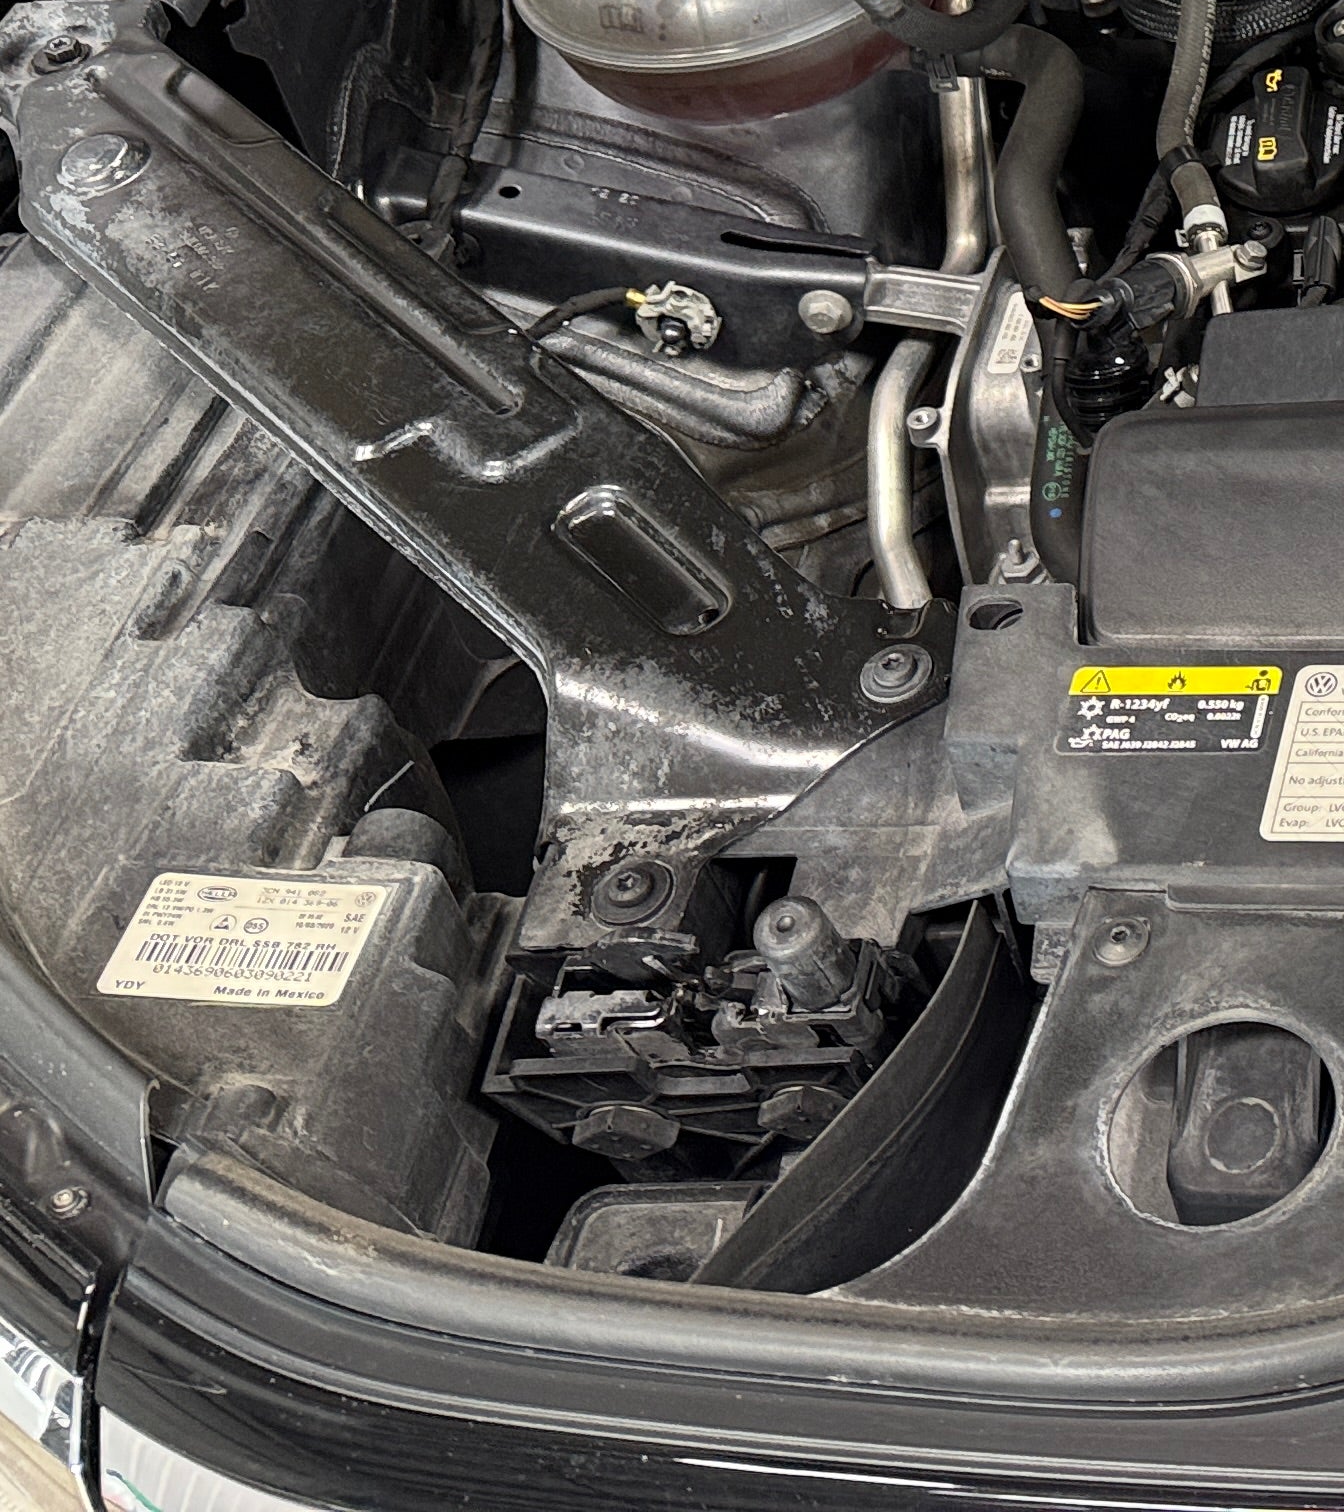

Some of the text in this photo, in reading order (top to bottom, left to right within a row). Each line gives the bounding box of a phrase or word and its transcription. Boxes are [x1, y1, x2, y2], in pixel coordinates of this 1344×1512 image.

[1110, 698, 1170, 712] R-1234yf
[1197, 699, 1245, 712] 0.550 kg
[1102, 728, 1131, 740] PAG
[1220, 738, 1259, 749] VW AG
[1288, 775, 1305, 785] No
[343, 913, 367, 924] SAE
[150, 932, 179, 942] DOT
[184, 934, 215, 945] VOR
[218, 936, 246, 946] DRL
[315, 942, 337, 952] RH
[115, 979, 146, 990] YDY
[213, 985, 252, 997] Made
[275, 988, 326, 1001] Mexico
